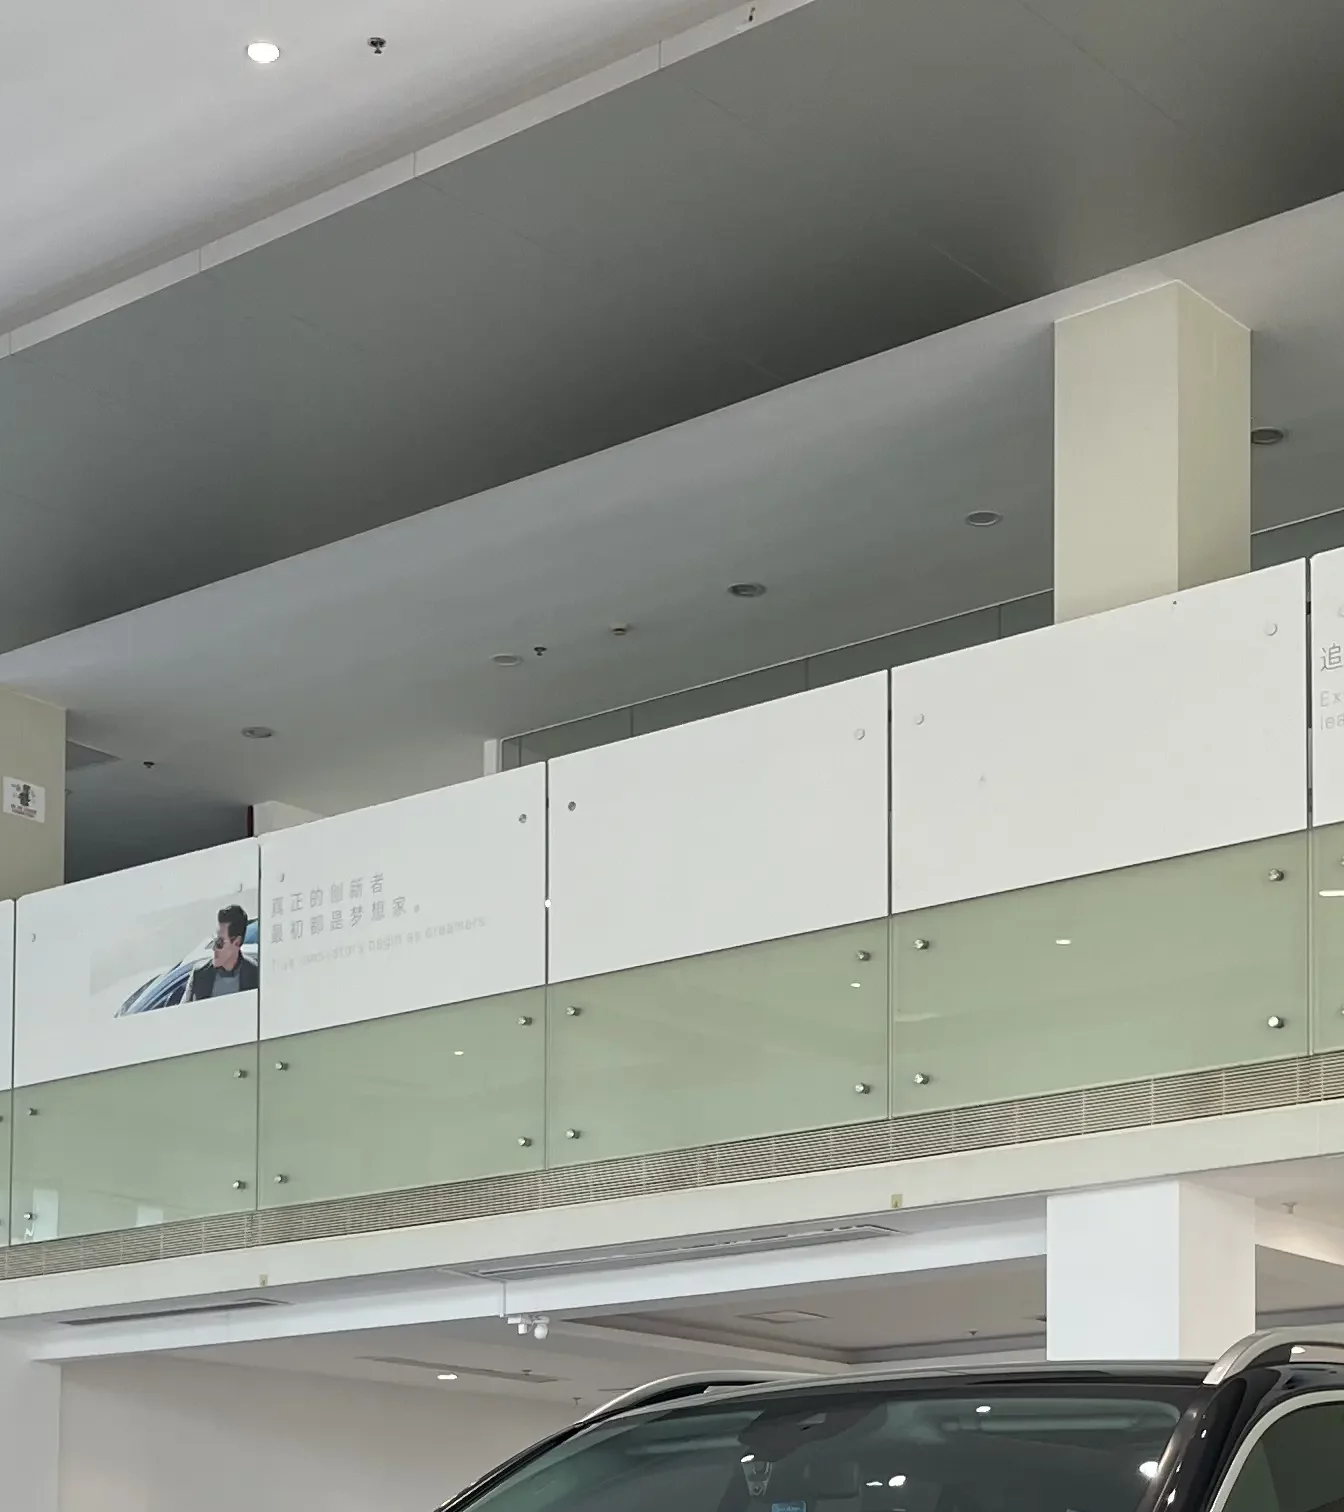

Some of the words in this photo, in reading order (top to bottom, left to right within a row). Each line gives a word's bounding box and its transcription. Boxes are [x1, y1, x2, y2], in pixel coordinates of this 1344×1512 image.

[270, 872, 385, 918] 真正的创新者
